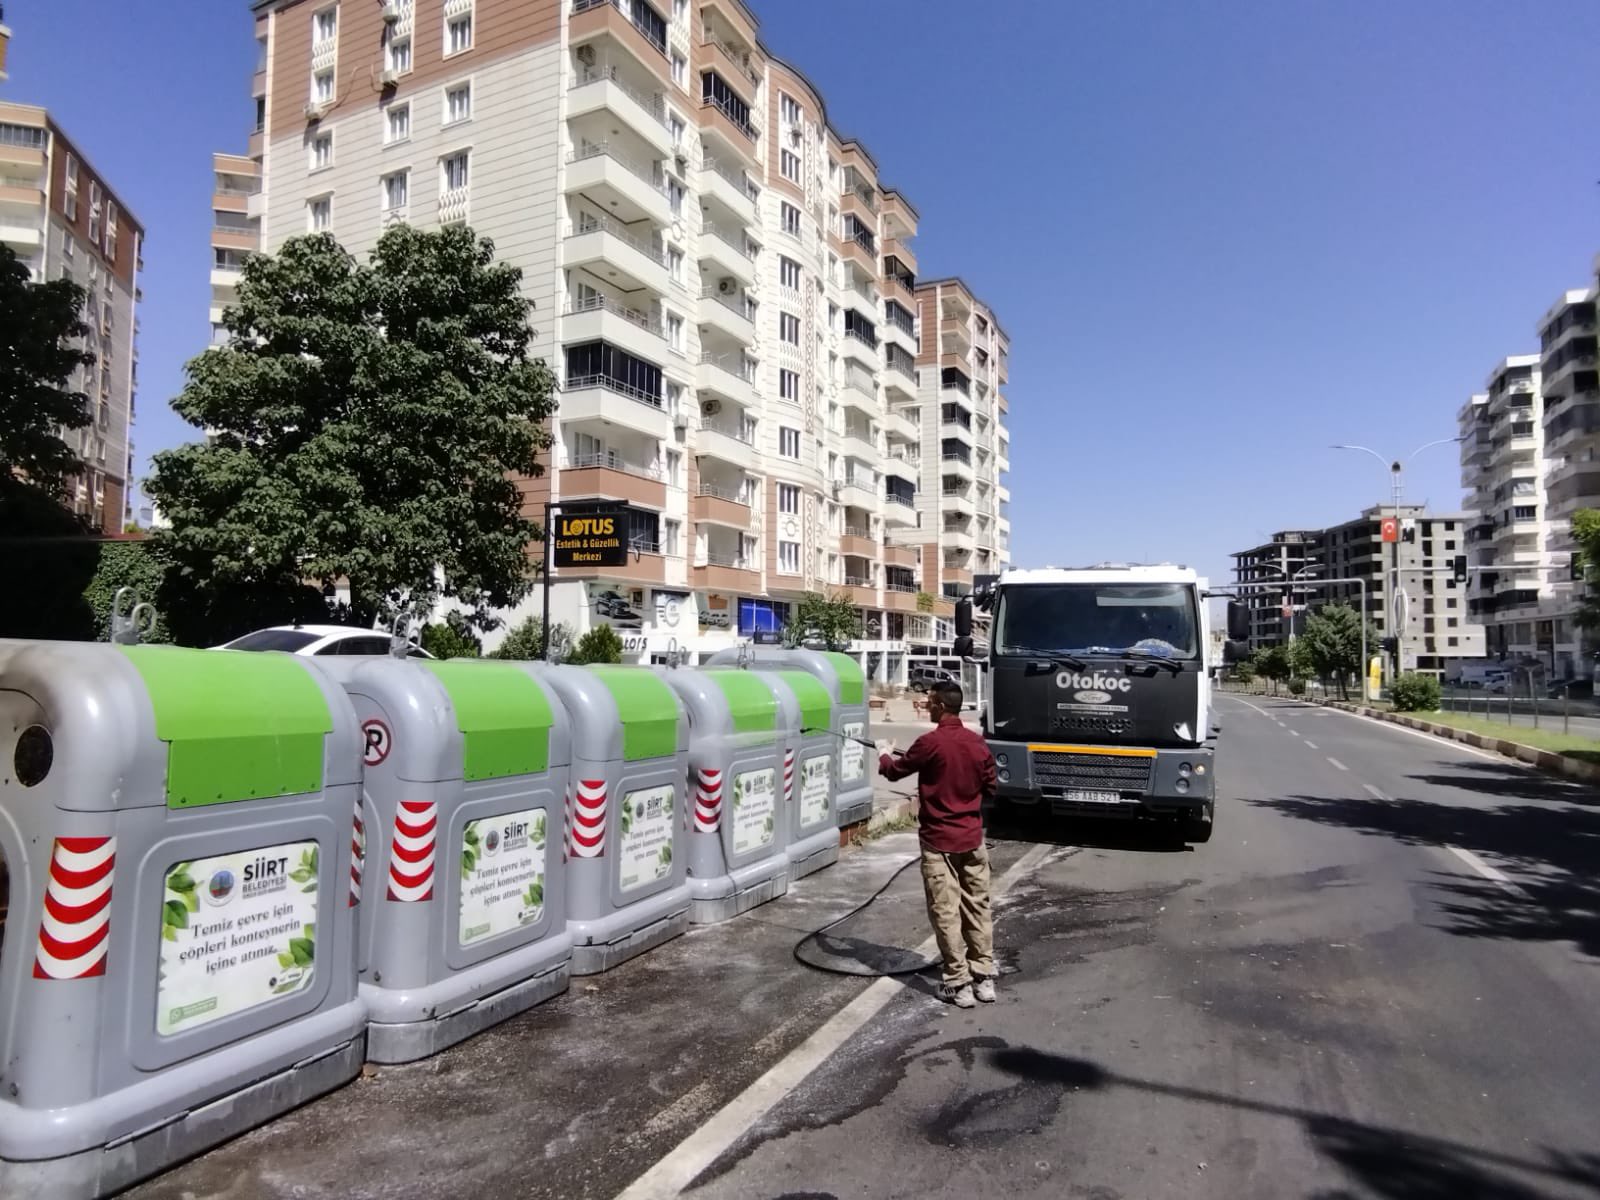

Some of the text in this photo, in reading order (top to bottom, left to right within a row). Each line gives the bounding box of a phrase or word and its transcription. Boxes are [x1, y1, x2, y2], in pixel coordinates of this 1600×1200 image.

[562, 518, 614, 536] LOTUS
[556, 538, 620, 549] Estetik & Güzellik
[572, 552, 602, 561] Merkezi
[624, 637, 648, 650] tors
[1056, 671, 1131, 692] Otokoç
[191, 903, 294, 939] Temiz çevre için
[179, 920, 300, 964] çöpleri konteynerin
[206, 957, 237, 976] içine
